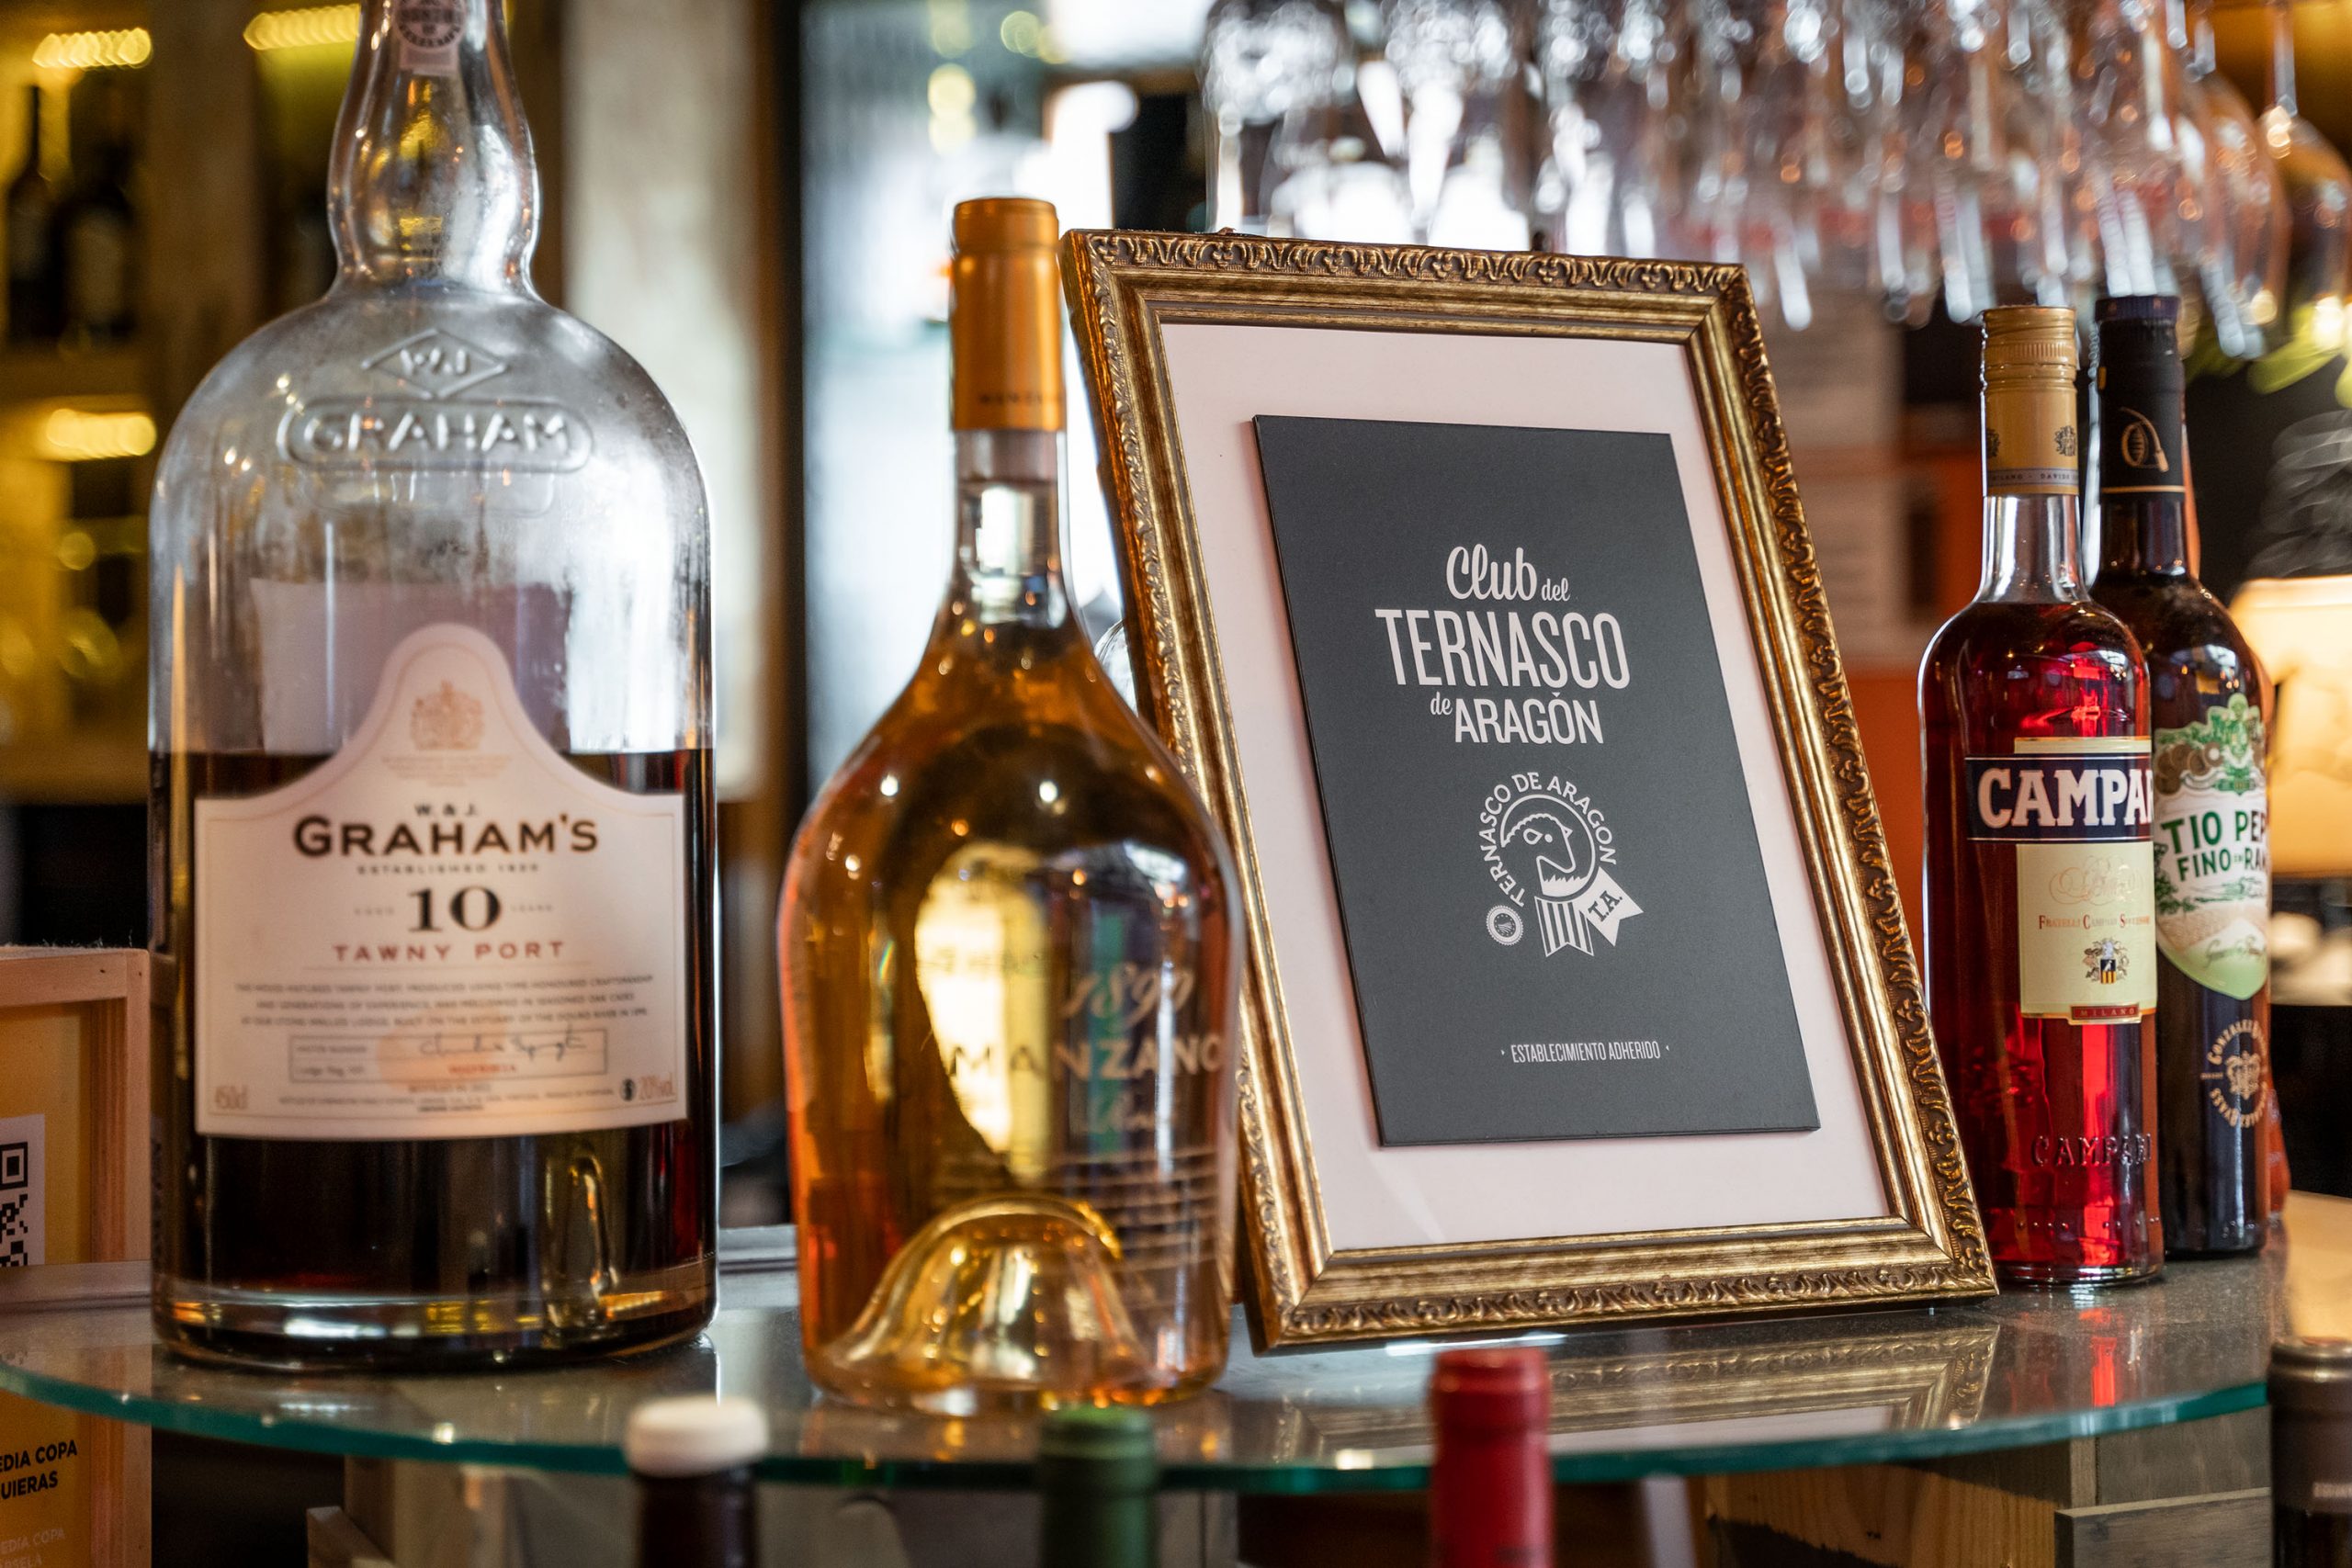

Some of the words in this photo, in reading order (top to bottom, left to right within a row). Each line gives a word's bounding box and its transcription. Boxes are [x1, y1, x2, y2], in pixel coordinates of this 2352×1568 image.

[303, 410, 573, 452] GRAHAM
[1446, 544, 1537, 601] Club
[1541, 578, 1570, 601] del
[1374, 609, 1631, 689] TERNASCO
[1430, 692, 1453, 715] de
[1454, 692, 1604, 745] ARAGÓN
[1978, 767, 2154, 828] CAMPA
[293, 813, 599, 858] GRAHAM'S
[1478, 784, 1525, 908] TERNASCO
[1511, 772, 1543, 793] DE
[1546, 775, 1617, 865] ARAGON
[2161, 811, 2222, 854] TIO
[2234, 809, 2266, 842] PEP
[2176, 848, 2232, 882] FINO
[2245, 847, 2267, 871] RA
[407, 885, 502, 933] 10
[333, 944, 452, 962] TAWNY
[473, 941, 565, 959] PORT
[2078, 1006, 2136, 1018] MILANO
[1510, 1043, 1607, 1063] ESTABLECIMIENTO
[1609, 1041, 1661, 1060] ADHERIDO
[2032, 1134, 2153, 1167] CAMPARI
[35, 1439, 78, 1465] COPA
[1, 1471, 59, 1500] UIERAS
[0, 1536, 29, 1555] EDIA
[32, 1528, 66, 1546] COPA
